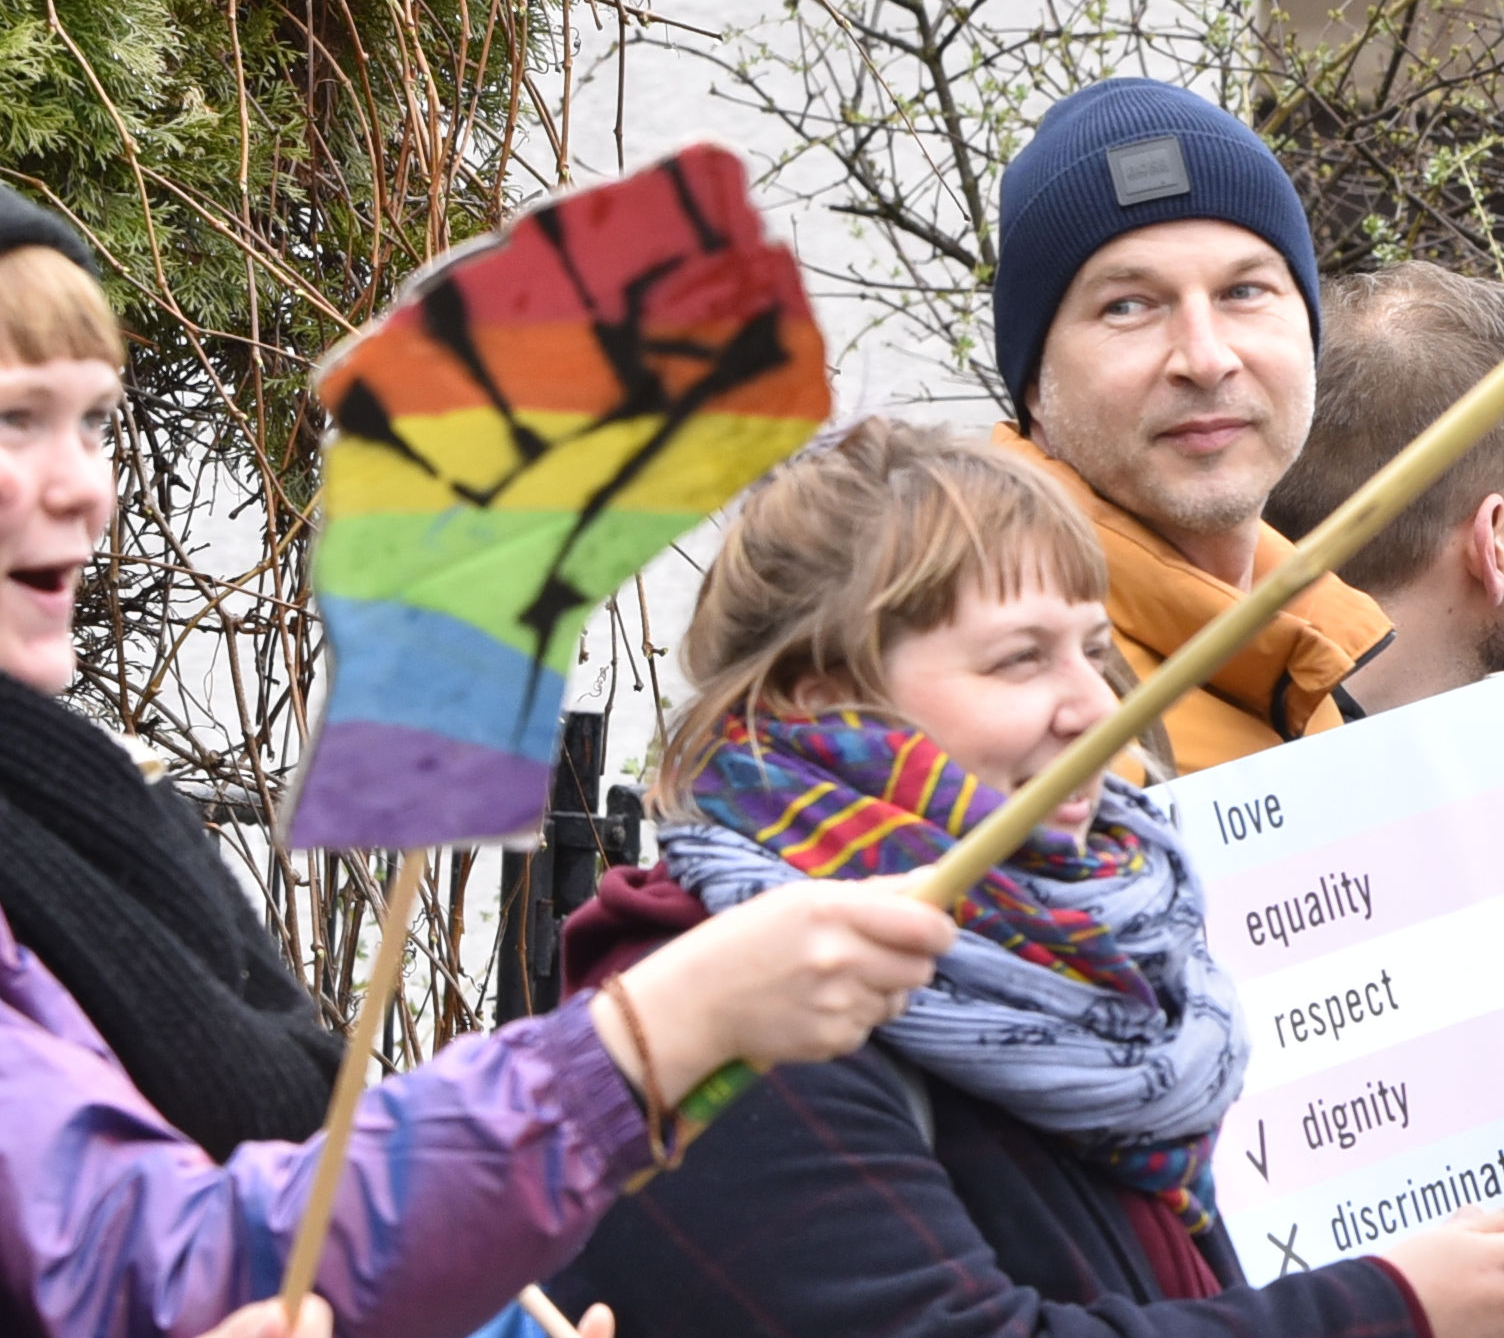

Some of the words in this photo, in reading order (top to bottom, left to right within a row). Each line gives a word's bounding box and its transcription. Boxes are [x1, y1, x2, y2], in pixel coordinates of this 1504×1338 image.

[1213, 794, 1284, 845] love
[1246, 871, 1373, 947] equality
[1274, 969, 1399, 1048] respect
[1302, 1080, 1409, 1150] dignity
